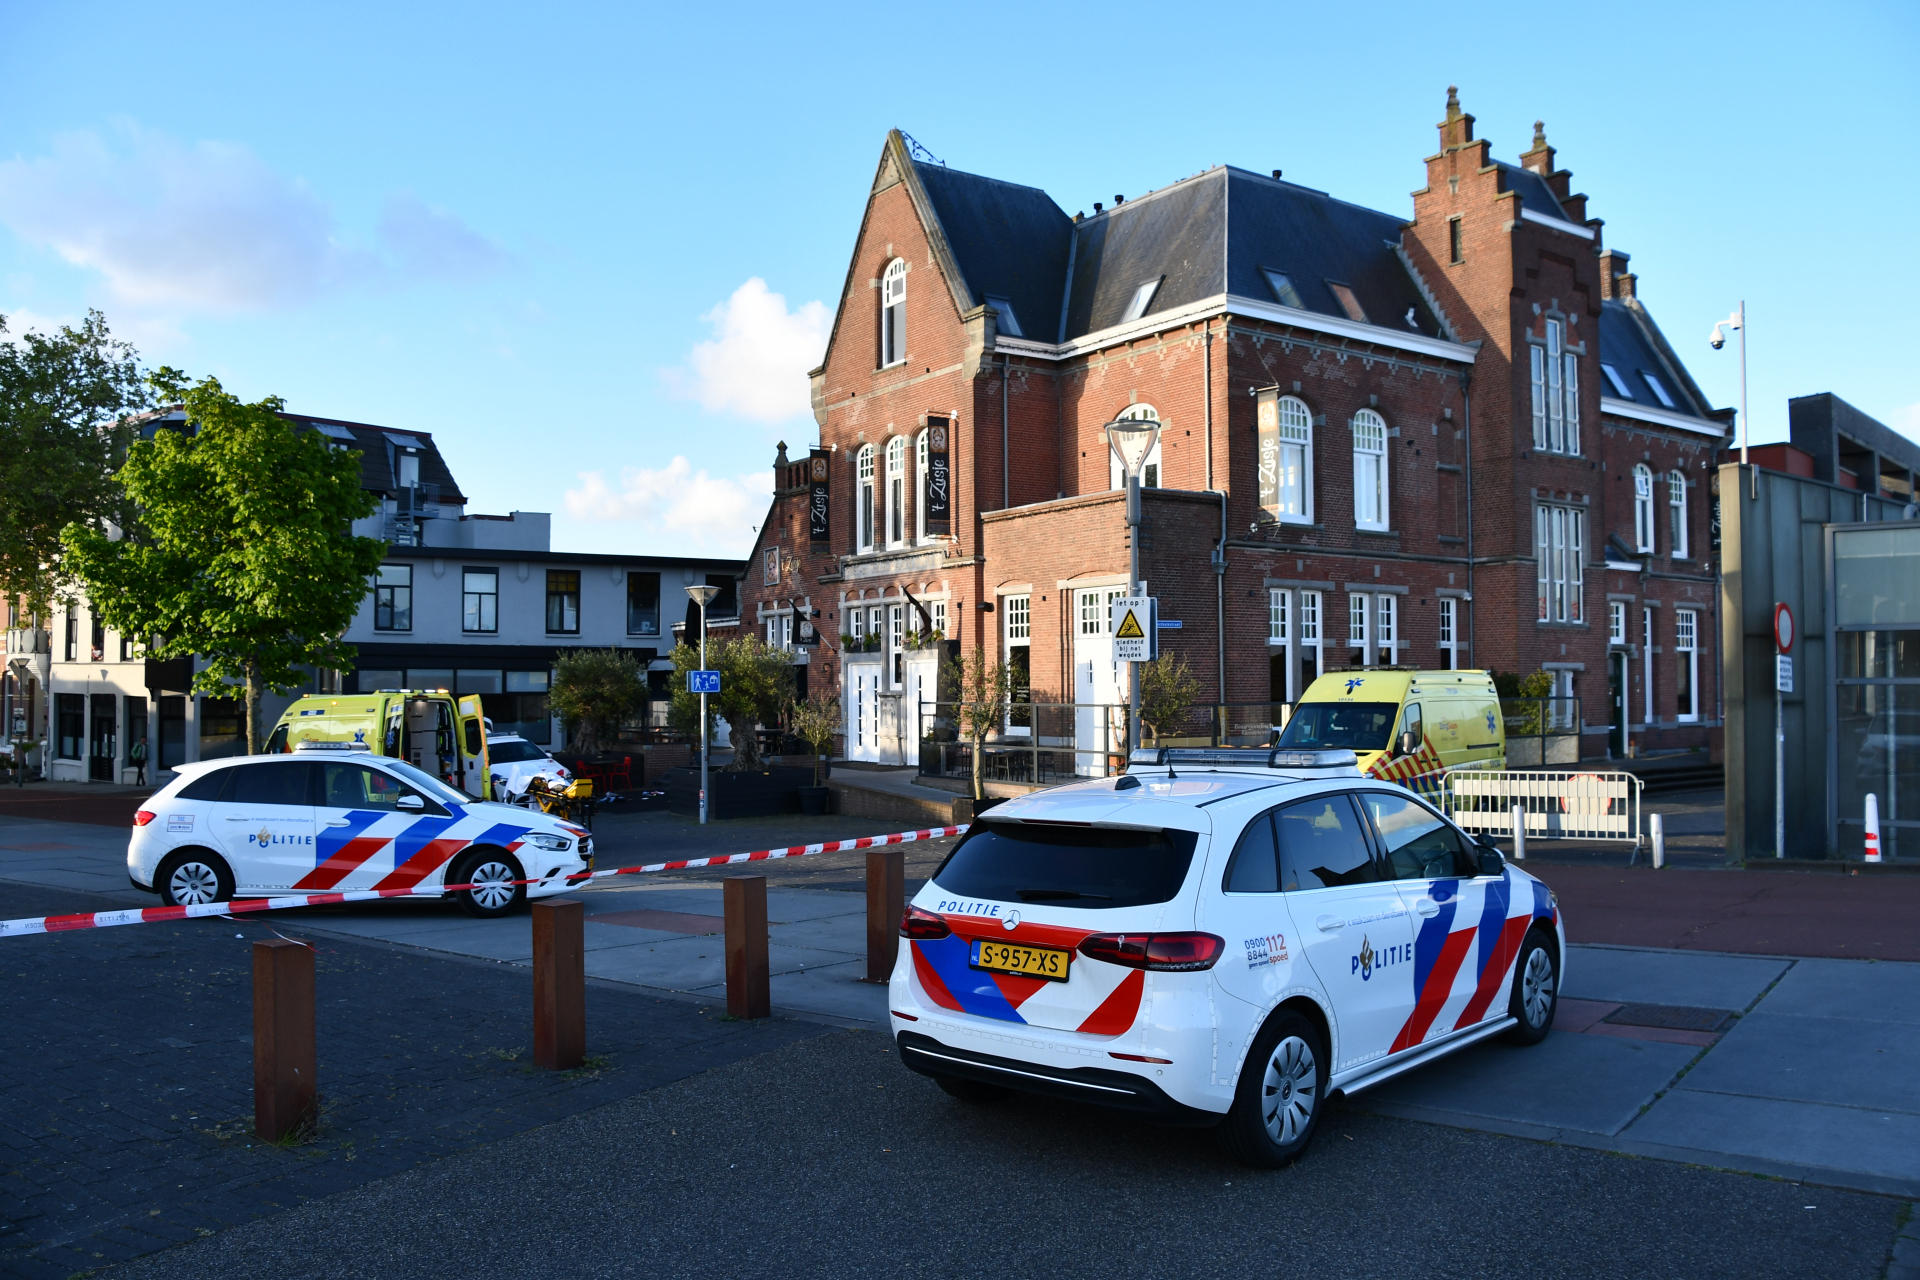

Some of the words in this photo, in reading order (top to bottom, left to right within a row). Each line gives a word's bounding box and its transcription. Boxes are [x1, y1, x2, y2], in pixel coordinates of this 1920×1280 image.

[1258, 438, 1279, 484] Zusje
[929, 459, 949, 501] Zusje
[810, 487, 829, 524] Zusje
[931, 503, 945, 512] 't
[812, 526, 825, 534] 't
[249, 834, 313, 848] POLITIE
[938, 900, 1001, 916] POLITIE
[1244, 937, 1266, 950] 0900
[1265, 933, 1287, 952] 112
[983, 945, 1059, 973] S-957-XS
[1247, 949, 1268, 961] 8844
[1269, 951, 1289, 965] spoed
[1351, 942, 1412, 981] POLITIE
